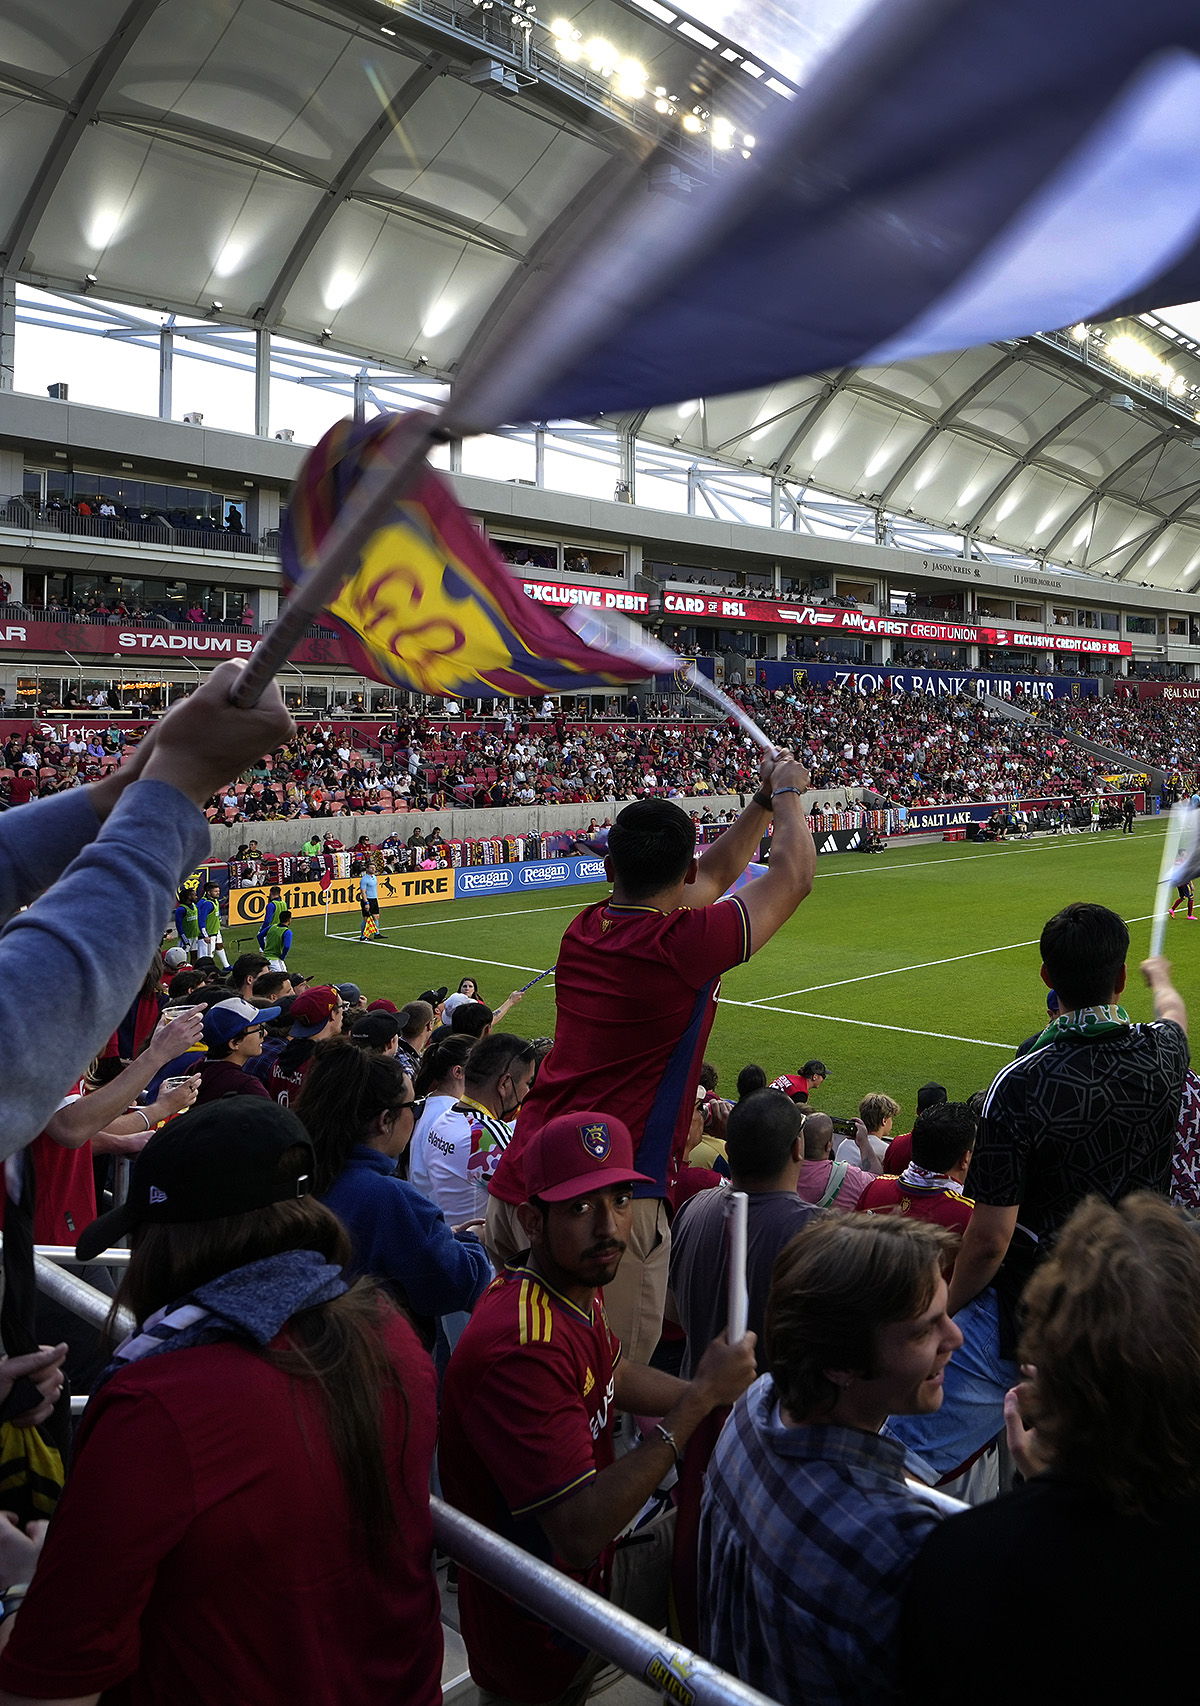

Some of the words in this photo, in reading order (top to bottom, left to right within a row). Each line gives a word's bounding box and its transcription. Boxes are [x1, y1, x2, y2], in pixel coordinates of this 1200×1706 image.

[923, 560, 928, 569] 9
[932, 562, 951, 572] JASON
[953, 565, 971, 576] KREIS
[1020, 576, 1038, 586] JAVIER
[1038, 579, 1061, 589] MORALES
[523, 584, 602, 607] EXCLUSIVE
[606, 594, 648, 611] DEBIT
[665, 596, 705, 612] CARD
[708, 602, 718, 613] OF
[722, 601, 746, 617] RSL
[878, 621, 909, 634] FIRST
[910, 624, 946, 638] CREDIT
[948, 627, 977, 641] UNION
[118, 632, 231, 652] STADIUM
[1014, 634, 1055, 648] EXCLUSIVE
[1056, 637, 1082, 650] CREDIT
[1082, 640, 1101, 651] CARD
[1108, 643, 1120, 653] RSL
[911, 676, 967, 697] BANK
[1163, 687, 1180, 700] REAL
[1183, 688, 1199, 699] SALT
[921, 814, 949, 827] SALT
[950, 812, 972, 825] LAKE
[523, 864, 565, 883] Reagan
[580, 859, 605, 878] Reag
[464, 870, 508, 889] Reagan
[237, 882, 363, 921] Cotinenta
[402, 877, 448, 896] TIRE
[649, 1658, 695, 1706] BELIEVE
